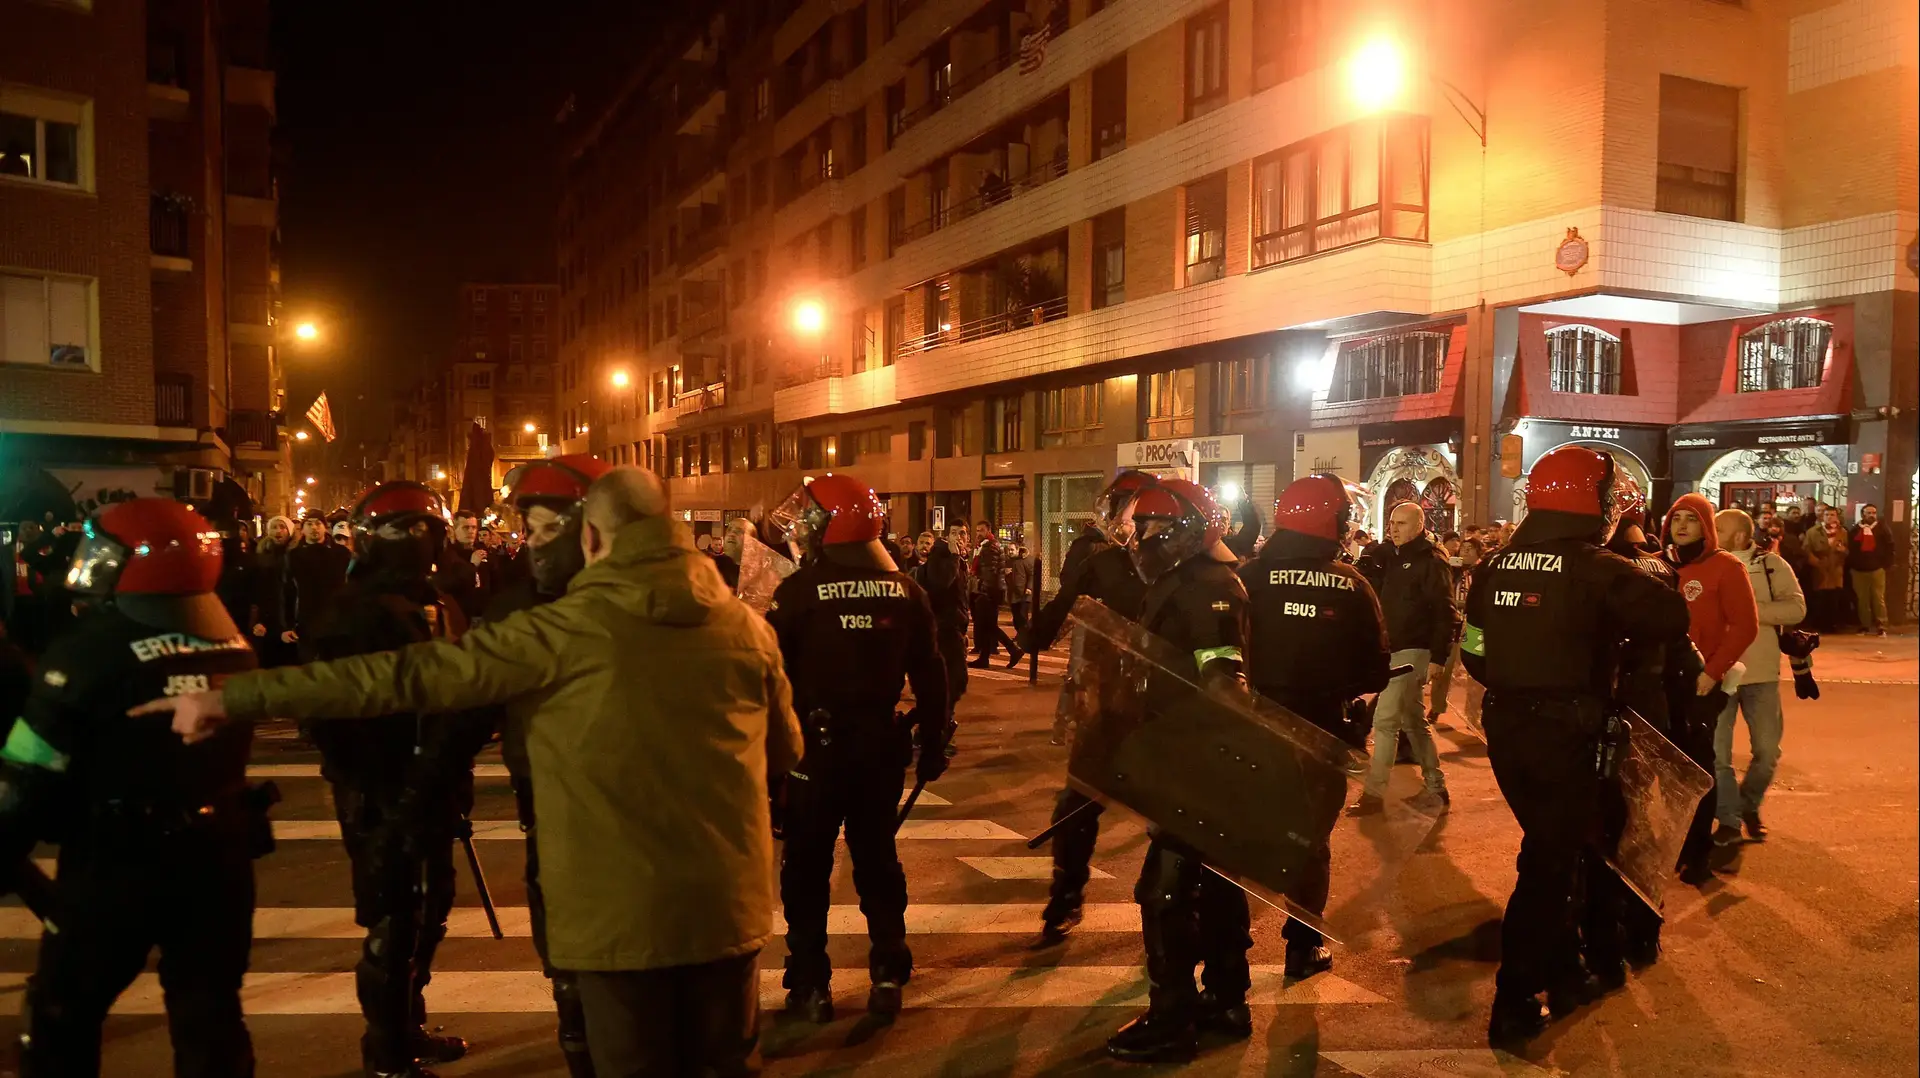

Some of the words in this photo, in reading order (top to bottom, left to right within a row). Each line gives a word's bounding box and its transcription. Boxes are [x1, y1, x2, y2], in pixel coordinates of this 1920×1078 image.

[1570, 426, 1620, 438] ANTXI
[1488, 552, 1563, 573] TZAINTZA
[1269, 570, 1355, 592] ERTZAINTZA
[817, 580, 906, 600] ERTZAINTZA
[1494, 590, 1521, 607] L7R7
[1283, 602, 1317, 618] E9U3
[839, 614, 873, 629] Y3G2
